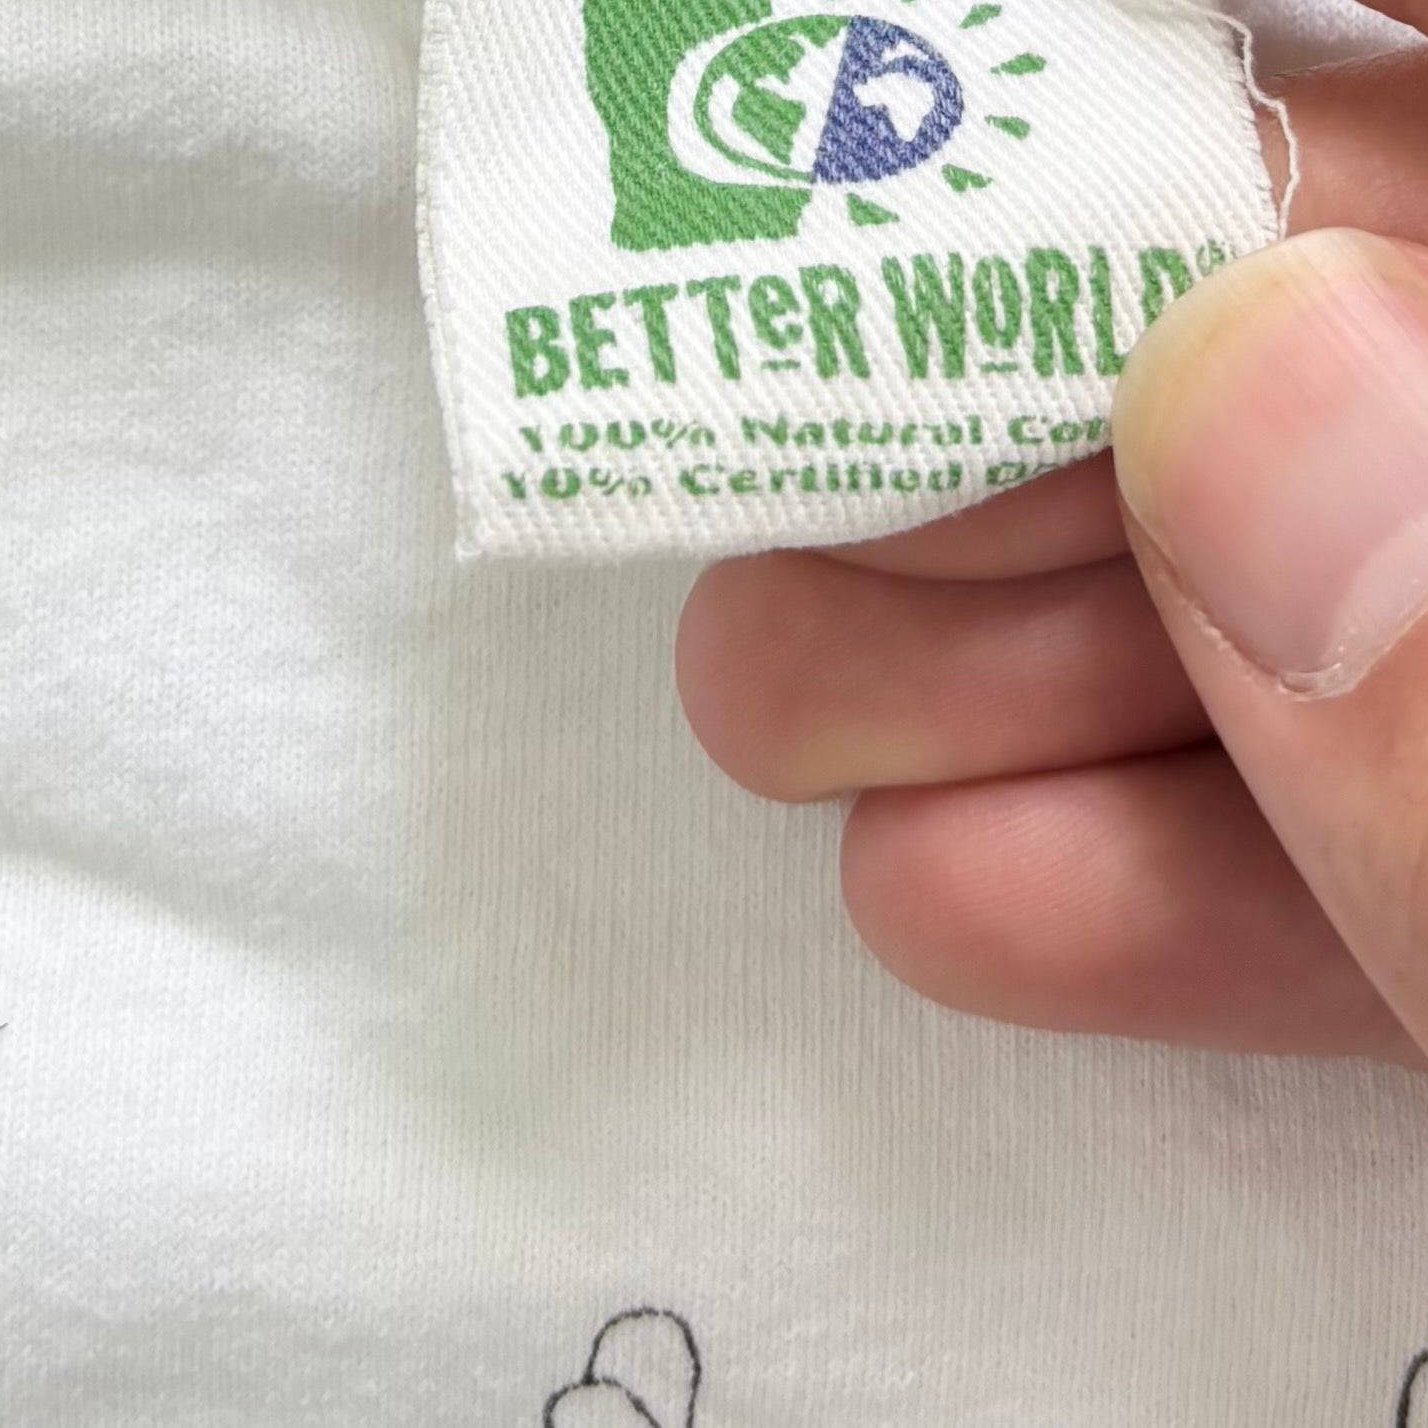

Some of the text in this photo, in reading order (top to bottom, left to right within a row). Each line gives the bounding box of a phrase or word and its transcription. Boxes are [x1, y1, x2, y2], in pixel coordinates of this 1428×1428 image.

[518, 417, 716, 453] 100%
[740, 412, 983, 447] Natural
[678, 460, 964, 495] Certified
